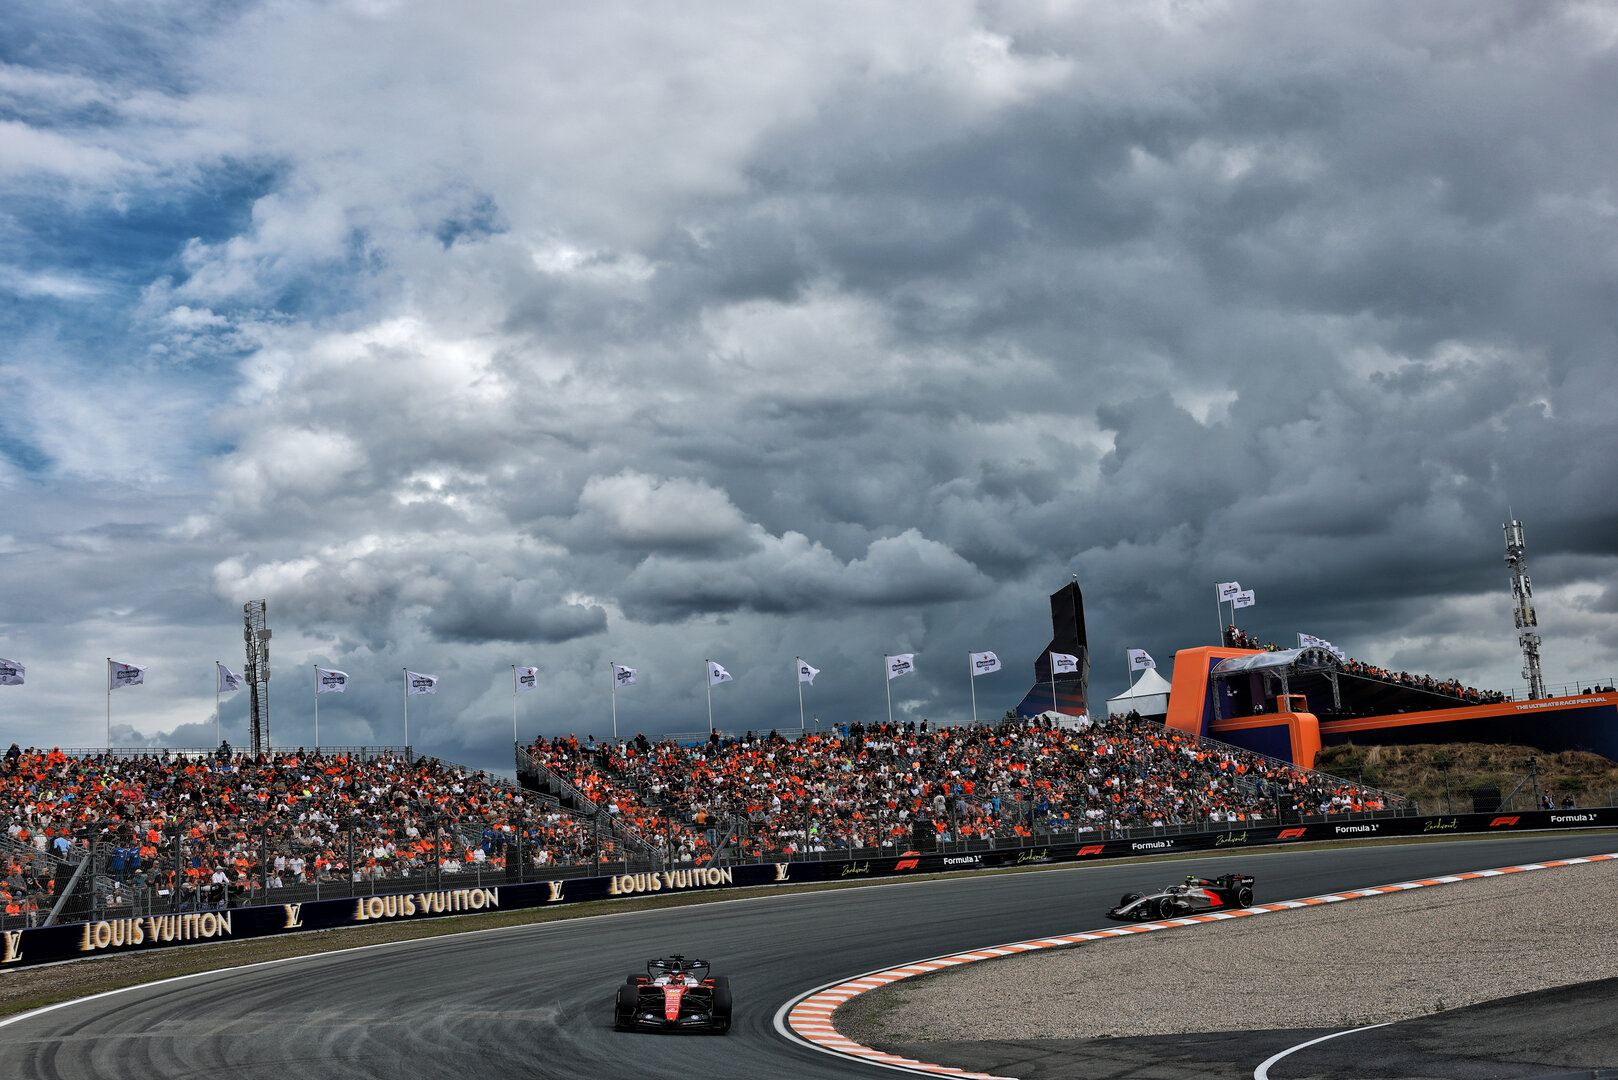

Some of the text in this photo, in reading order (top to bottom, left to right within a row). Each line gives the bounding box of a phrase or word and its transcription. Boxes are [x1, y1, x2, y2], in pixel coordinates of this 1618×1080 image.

[1551, 815, 1588, 823] Formula
[1335, 825, 1370, 833] Formula
[1132, 841, 1165, 850] Formula
[943, 856, 974, 865] Formula
[611, 867, 733, 895] LOUIS VUITTON
[358, 887, 498, 920] LOUIS VUITTON
[84, 911, 232, 950] LOUIS VUITTON
